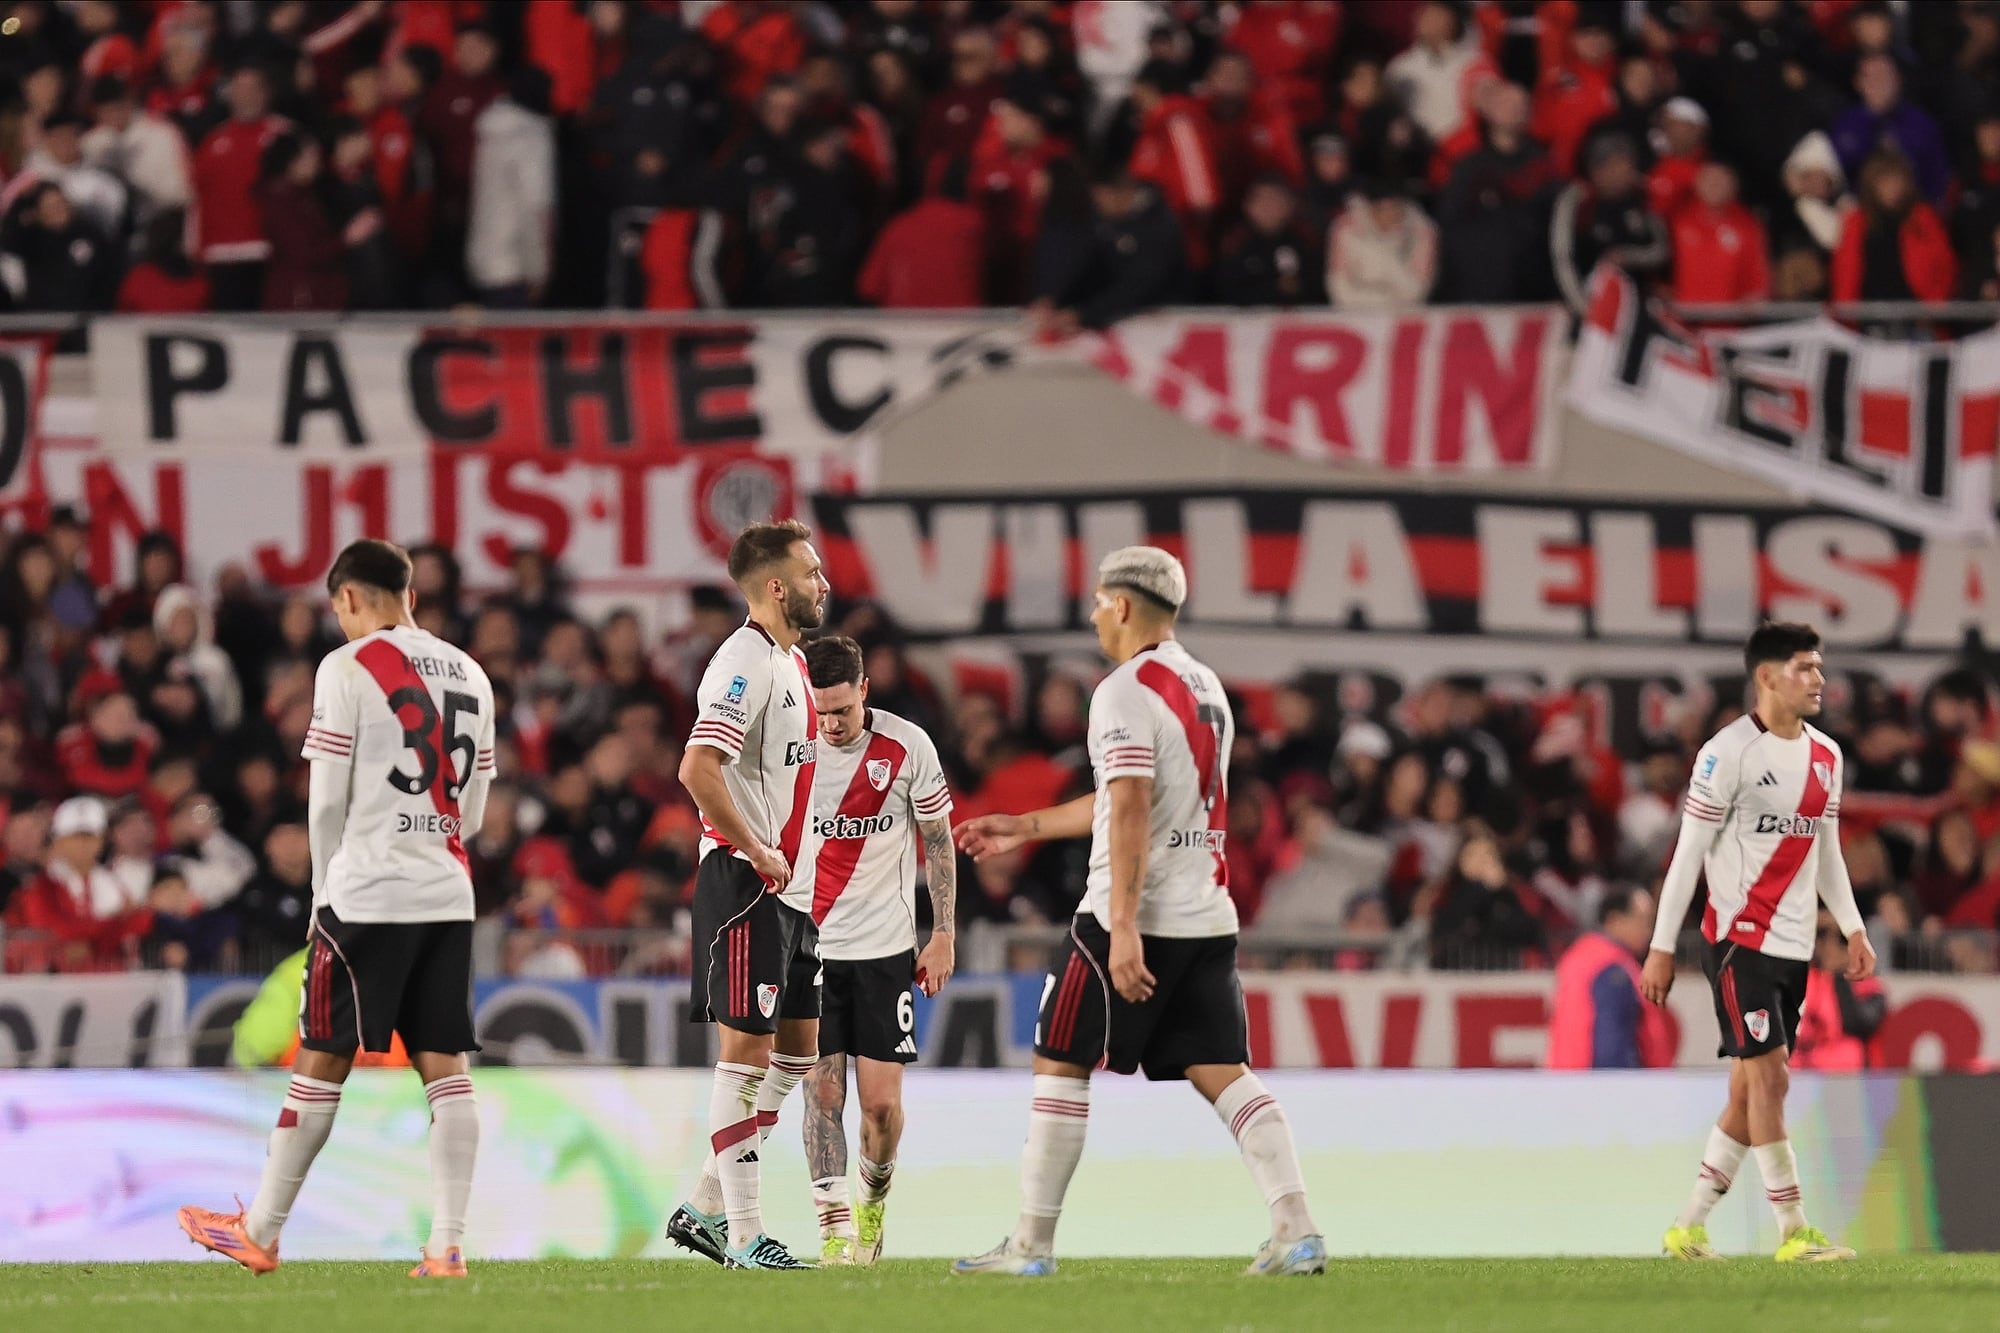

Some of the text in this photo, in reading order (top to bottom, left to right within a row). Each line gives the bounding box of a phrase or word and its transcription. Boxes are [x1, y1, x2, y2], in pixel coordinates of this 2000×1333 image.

[844, 497, 2000, 652] VILLA ELISA
[402, 655, 468, 682] FREITAS
[709, 702, 748, 717] ASSIST
[719, 710, 747, 725] CARD
[387, 685, 480, 801] 35
[1197, 703, 1227, 812] 7
[896, 990, 915, 1034] 6
